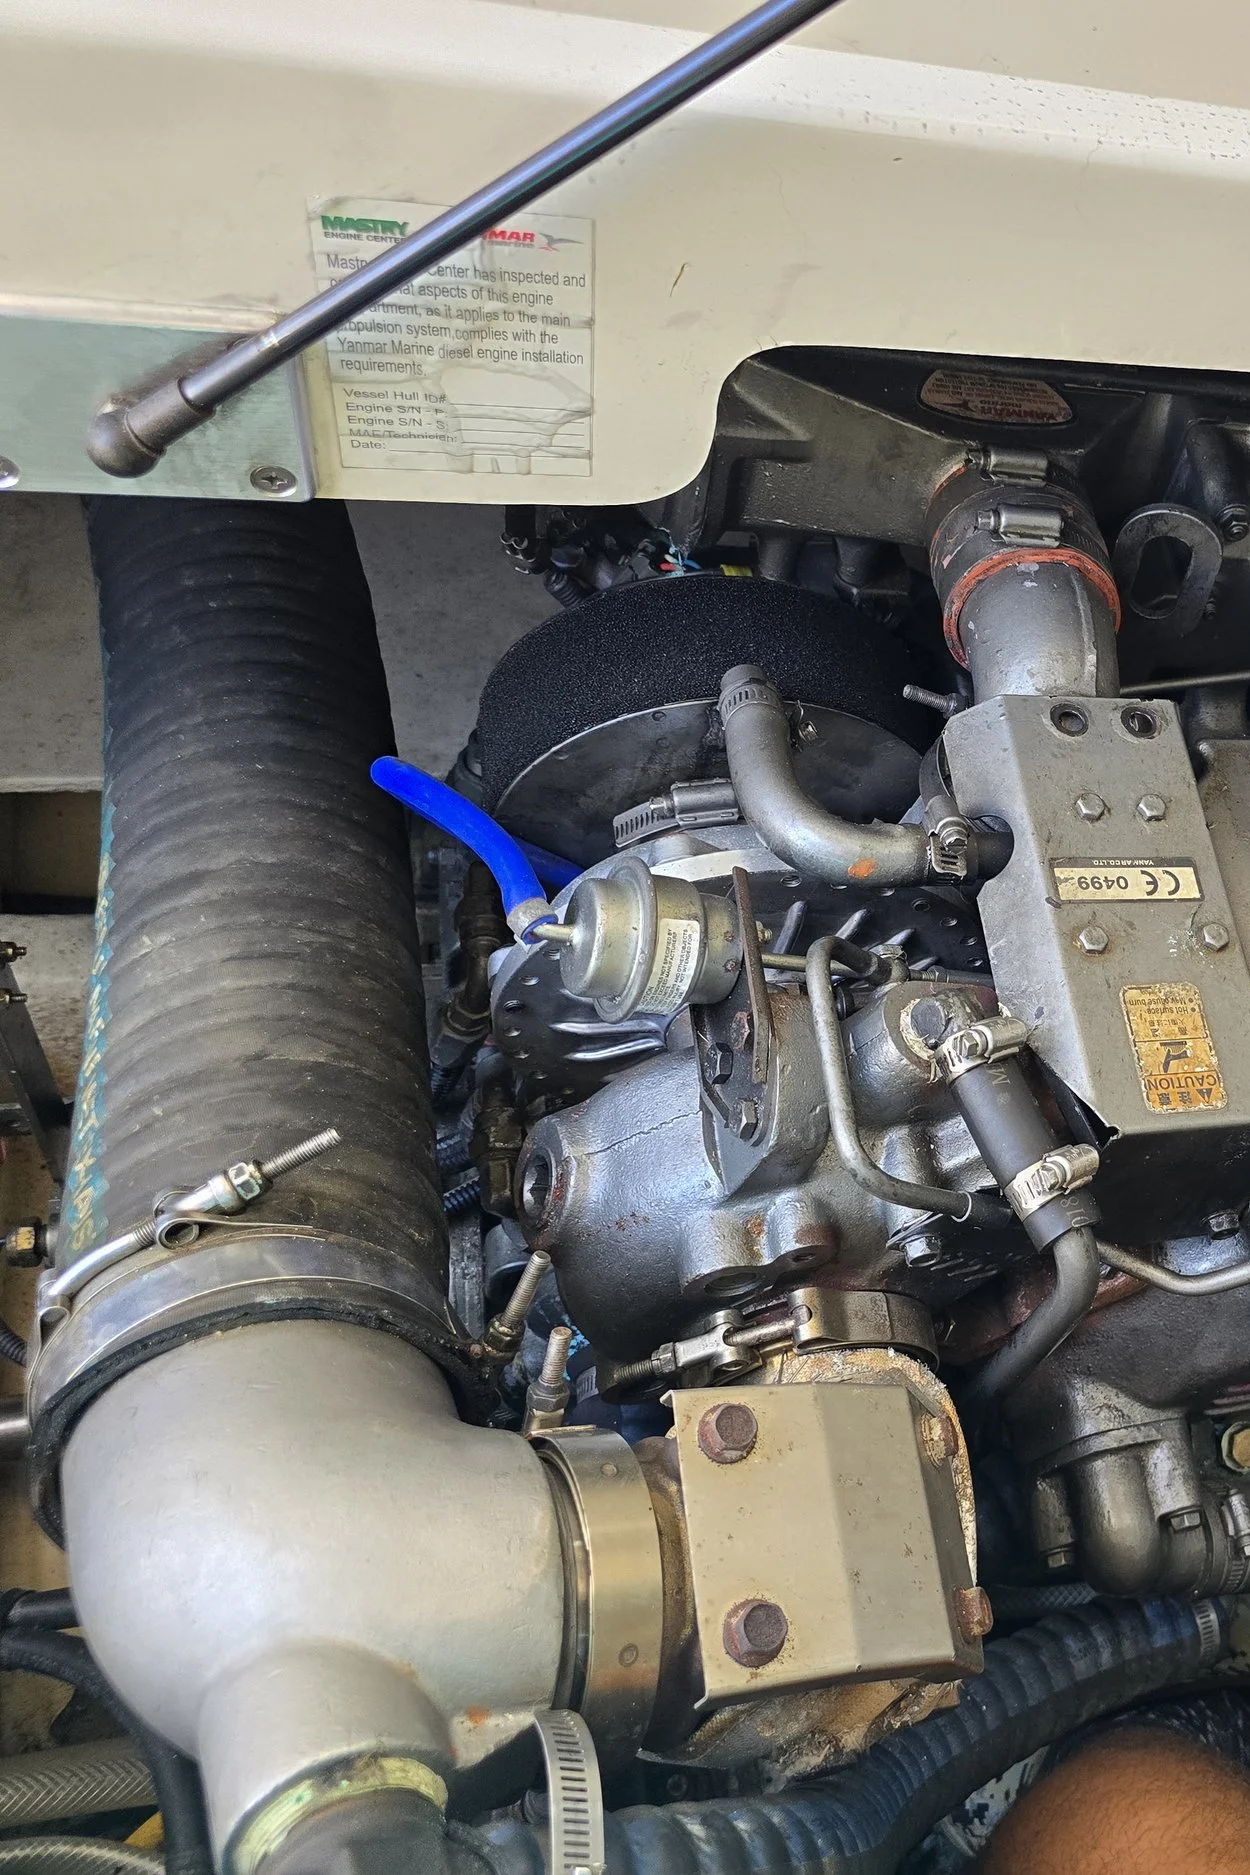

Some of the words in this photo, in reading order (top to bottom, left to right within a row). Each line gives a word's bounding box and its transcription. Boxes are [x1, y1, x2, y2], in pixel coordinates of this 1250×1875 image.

[321, 215, 410, 236] MASTRY
[324, 232, 364, 240] ENGINE
[366, 235, 406, 243] CENTE
[481, 230, 535, 242] MAR
[327, 254, 368, 269] Mastr
[473, 265, 496, 282] has
[500, 268, 559, 285] inspected
[563, 273, 586, 287] and
[419, 285, 467, 300] aspects
[472, 287, 484, 298] of
[488, 288, 508, 302] this
[512, 292, 553, 307] engine
[426, 307, 440, 317] as
[445, 304, 452, 318] it
[456, 308, 499, 323] applies
[503, 311, 514, 321] to
[518, 311, 537, 323] the
[541, 314, 570, 326] main
[455, 328, 508, 343] complies
[512, 330, 536, 343] with
[540, 331, 559, 344] the
[338, 337, 388, 354] Yanmar
[392, 340, 434, 356] Marine
[438, 344, 473, 359] diesel
[477, 349, 518, 362] engine
[522, 348, 584, 365] installation
[341, 358, 427, 376] requirements.
[343, 388, 388, 399] Vessel
[394, 392, 418, 401] Hull
[424, 394, 447, 404] ID#
[346, 402, 392, 413] Engine
[397, 406, 421, 414] S/N
[348, 416, 394, 426] Engine
[399, 418, 422, 426] S/N
[351, 440, 386, 449] Date:
[1076, 875, 1128, 889] 0499
[662, 937, 671, 965] SPECIFIED
[682, 945, 691, 972] INTENDED
[1144, 1074, 1217, 1087] CAUTION
[1157, 1092, 1192, 1106] 注意
